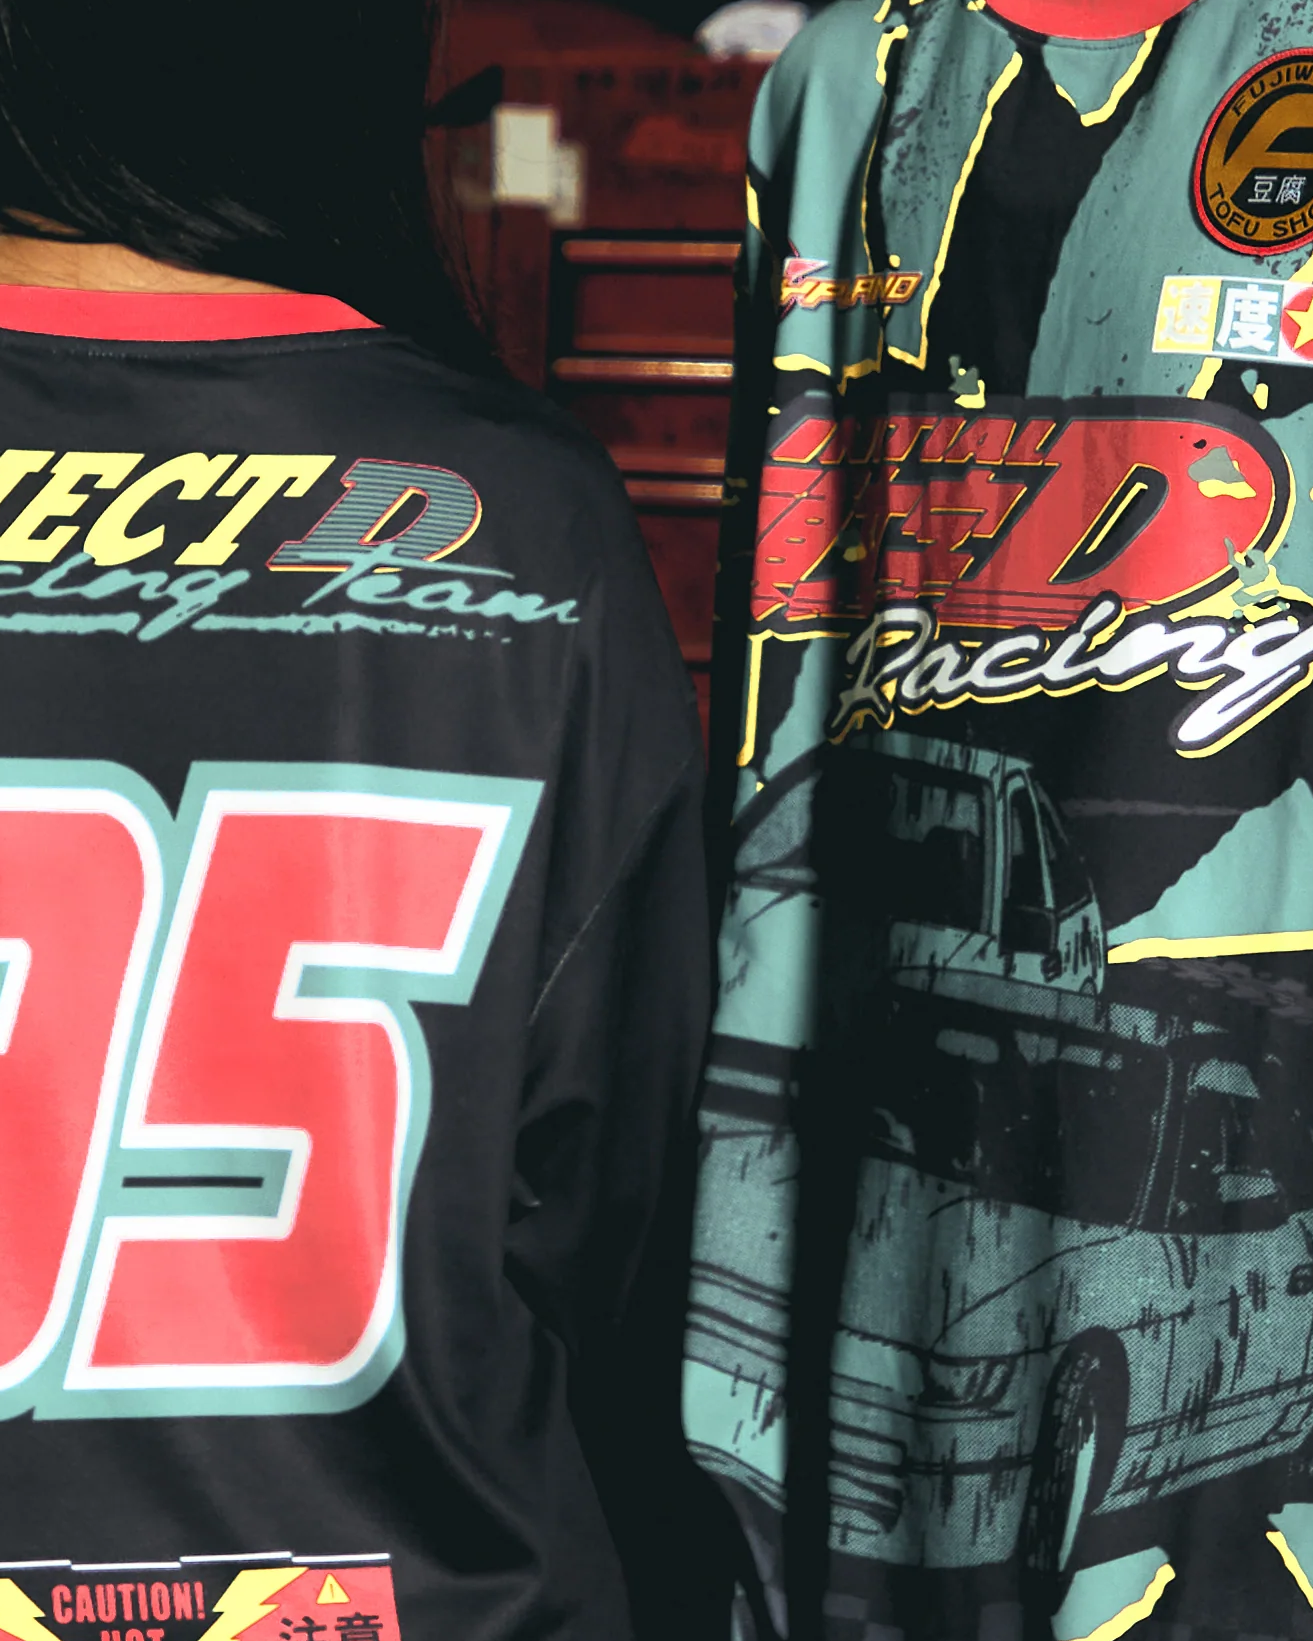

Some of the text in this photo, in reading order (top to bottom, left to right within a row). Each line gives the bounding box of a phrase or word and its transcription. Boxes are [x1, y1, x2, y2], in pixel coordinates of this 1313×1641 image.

[1207, 183, 1261, 238] TOFU
[1247, 174, 1307, 205] 豆腐
[266, 457, 484, 574] D
[288, 546, 581, 625] Team
[50, 1580, 206, 1624] CAUTION!
